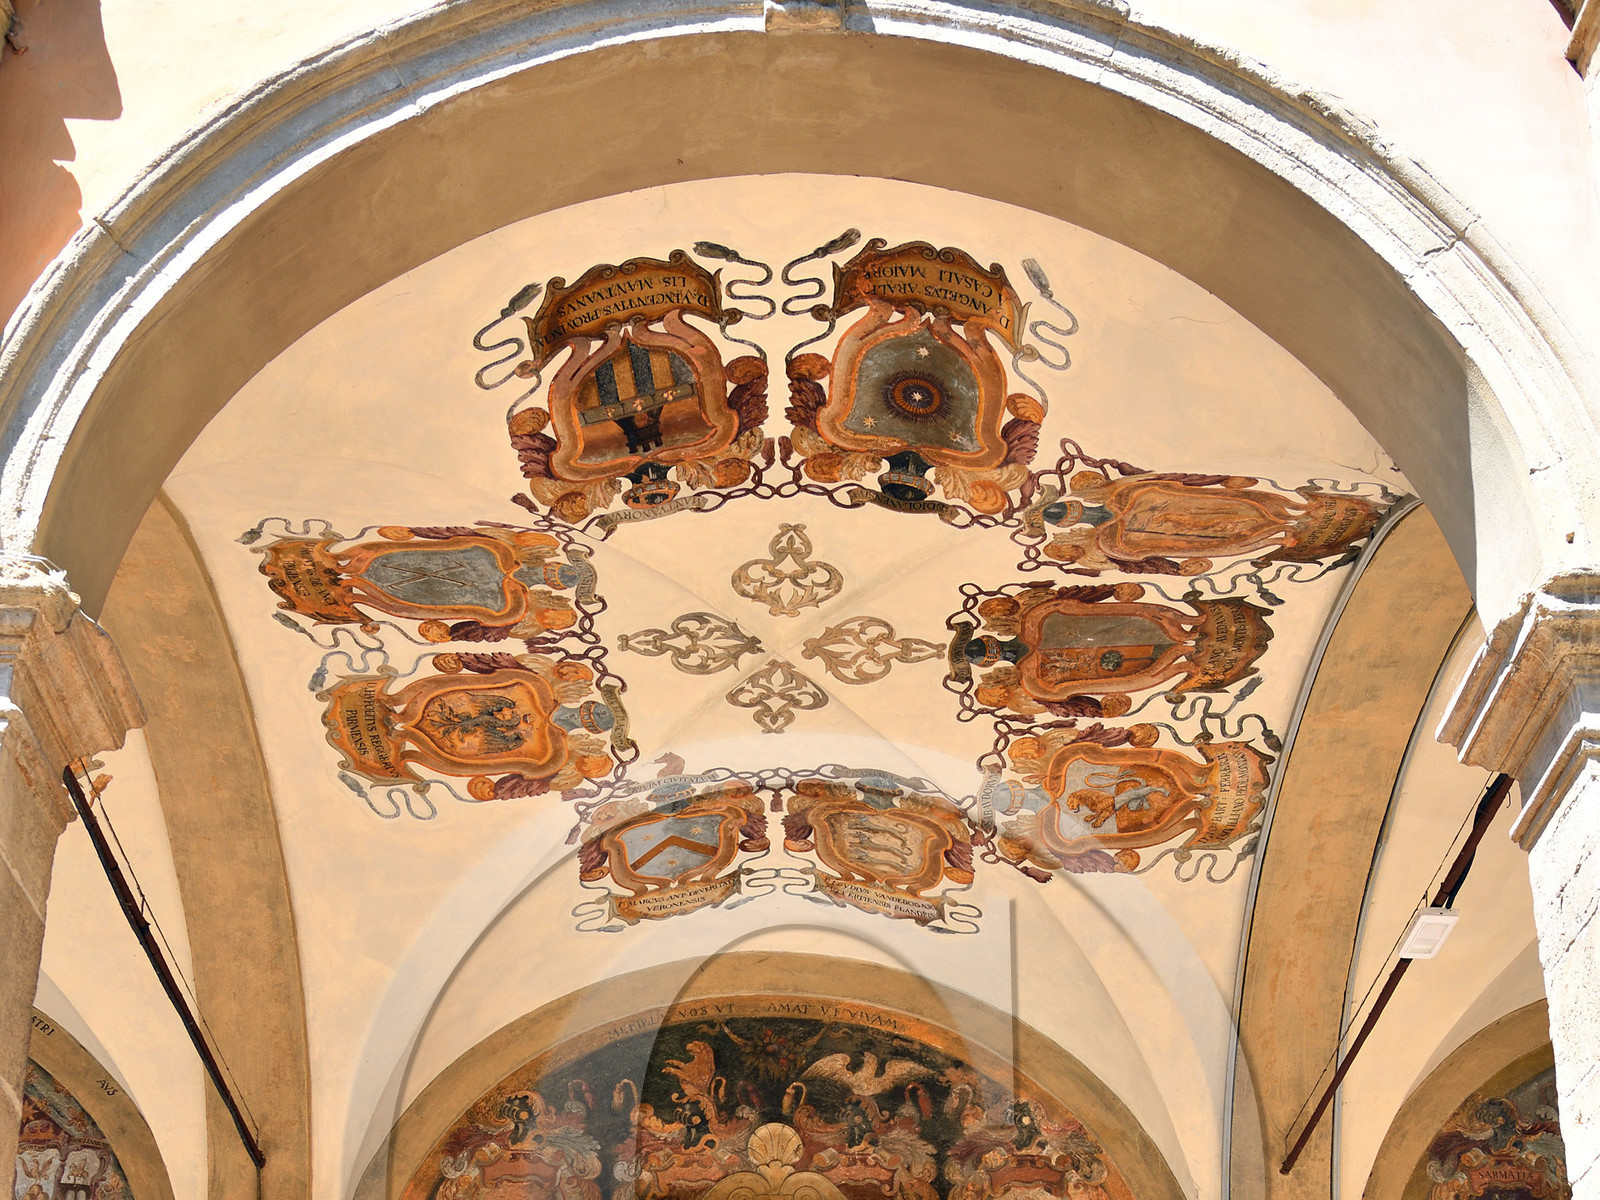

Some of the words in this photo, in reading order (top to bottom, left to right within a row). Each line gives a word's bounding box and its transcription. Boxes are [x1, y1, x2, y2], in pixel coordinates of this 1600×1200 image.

[679, 1006, 708, 1018] VOS
[715, 1003, 735, 1014] VT
[767, 1003, 810, 1014] AMAT
